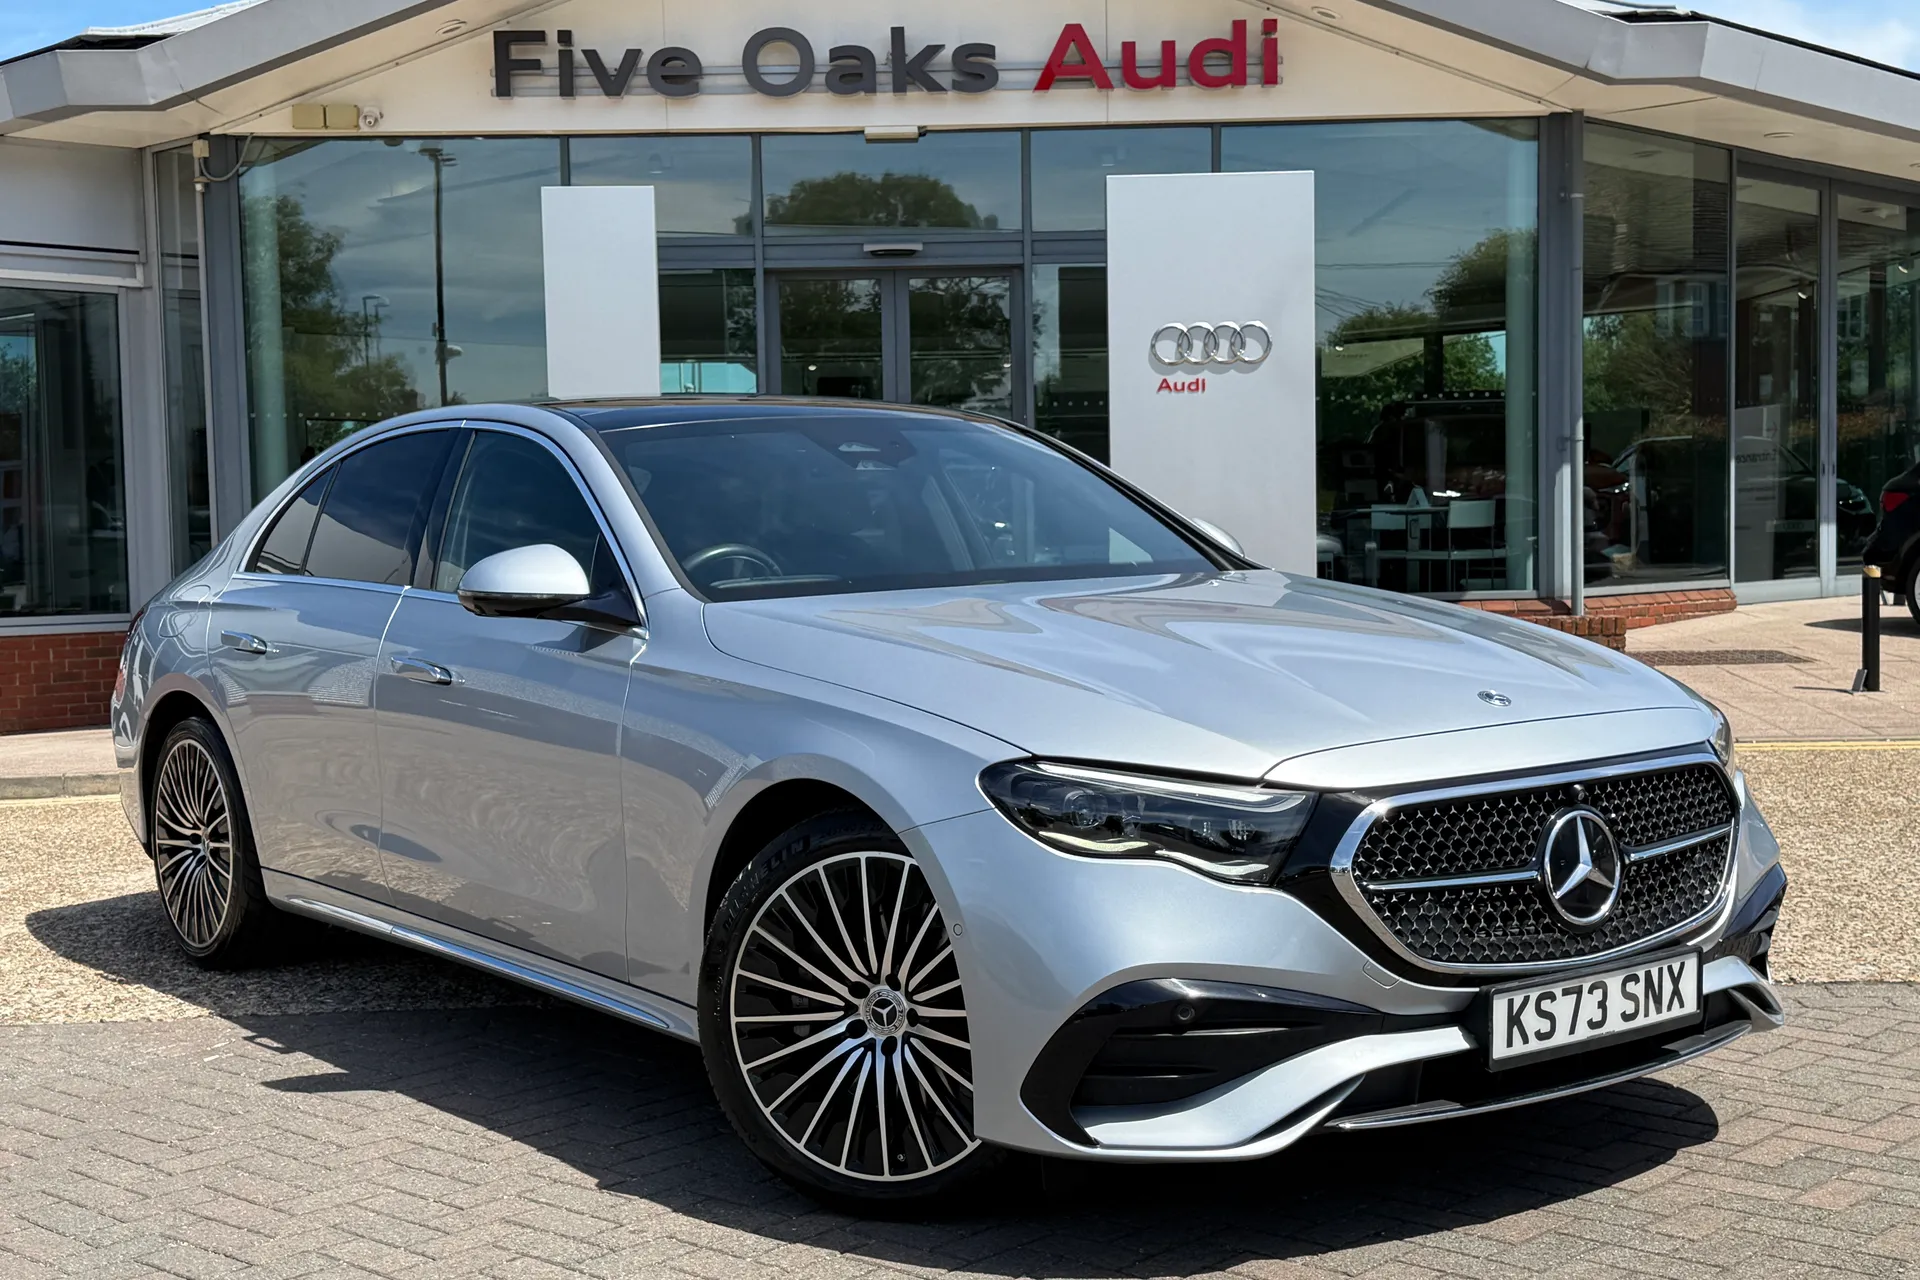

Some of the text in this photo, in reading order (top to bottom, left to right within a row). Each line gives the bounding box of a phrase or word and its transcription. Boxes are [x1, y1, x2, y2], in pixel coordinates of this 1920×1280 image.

[493, 18, 1279, 98] Five Oaks Audi
[1156, 377, 1206, 394] Audi
[1506, 961, 1685, 1049] KS73 SNX
